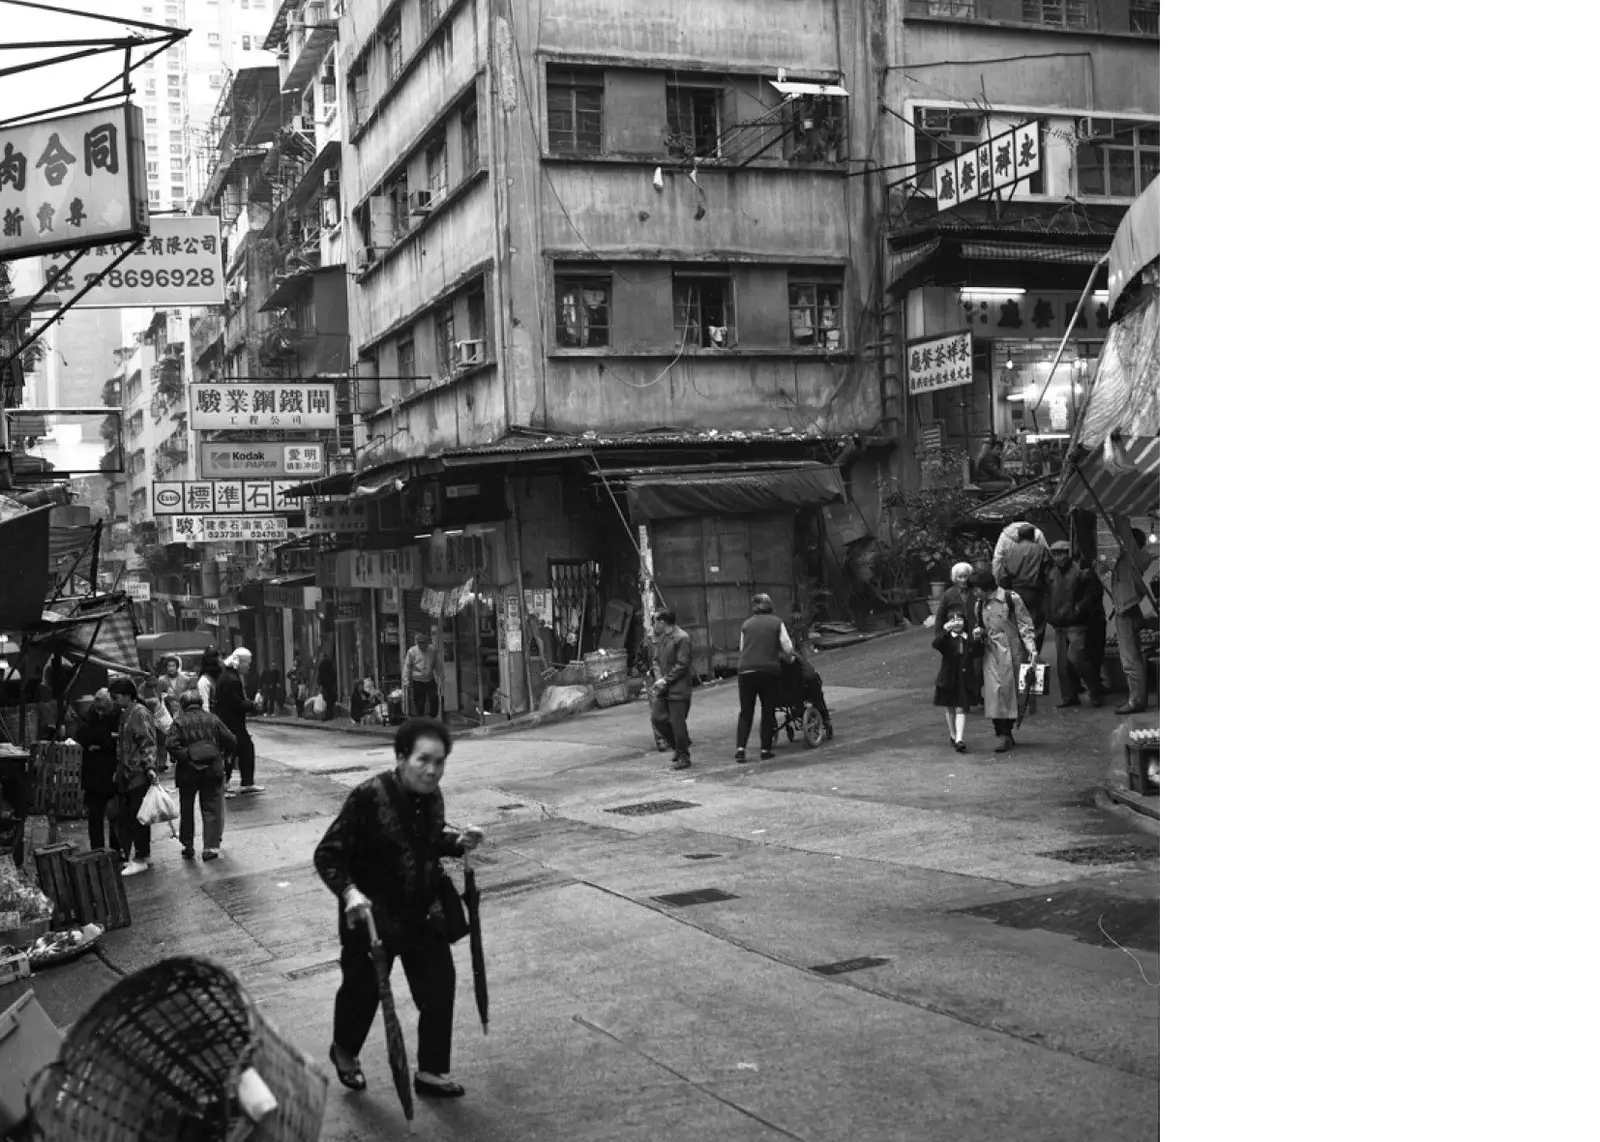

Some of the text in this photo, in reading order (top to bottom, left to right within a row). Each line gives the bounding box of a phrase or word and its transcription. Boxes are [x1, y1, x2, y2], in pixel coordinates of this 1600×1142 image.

[108, 268, 215, 288] 8696928
[232, 451, 265, 461] Kodak
[245, 461, 277, 469] PAPER
[160, 493, 178, 502] Esso
